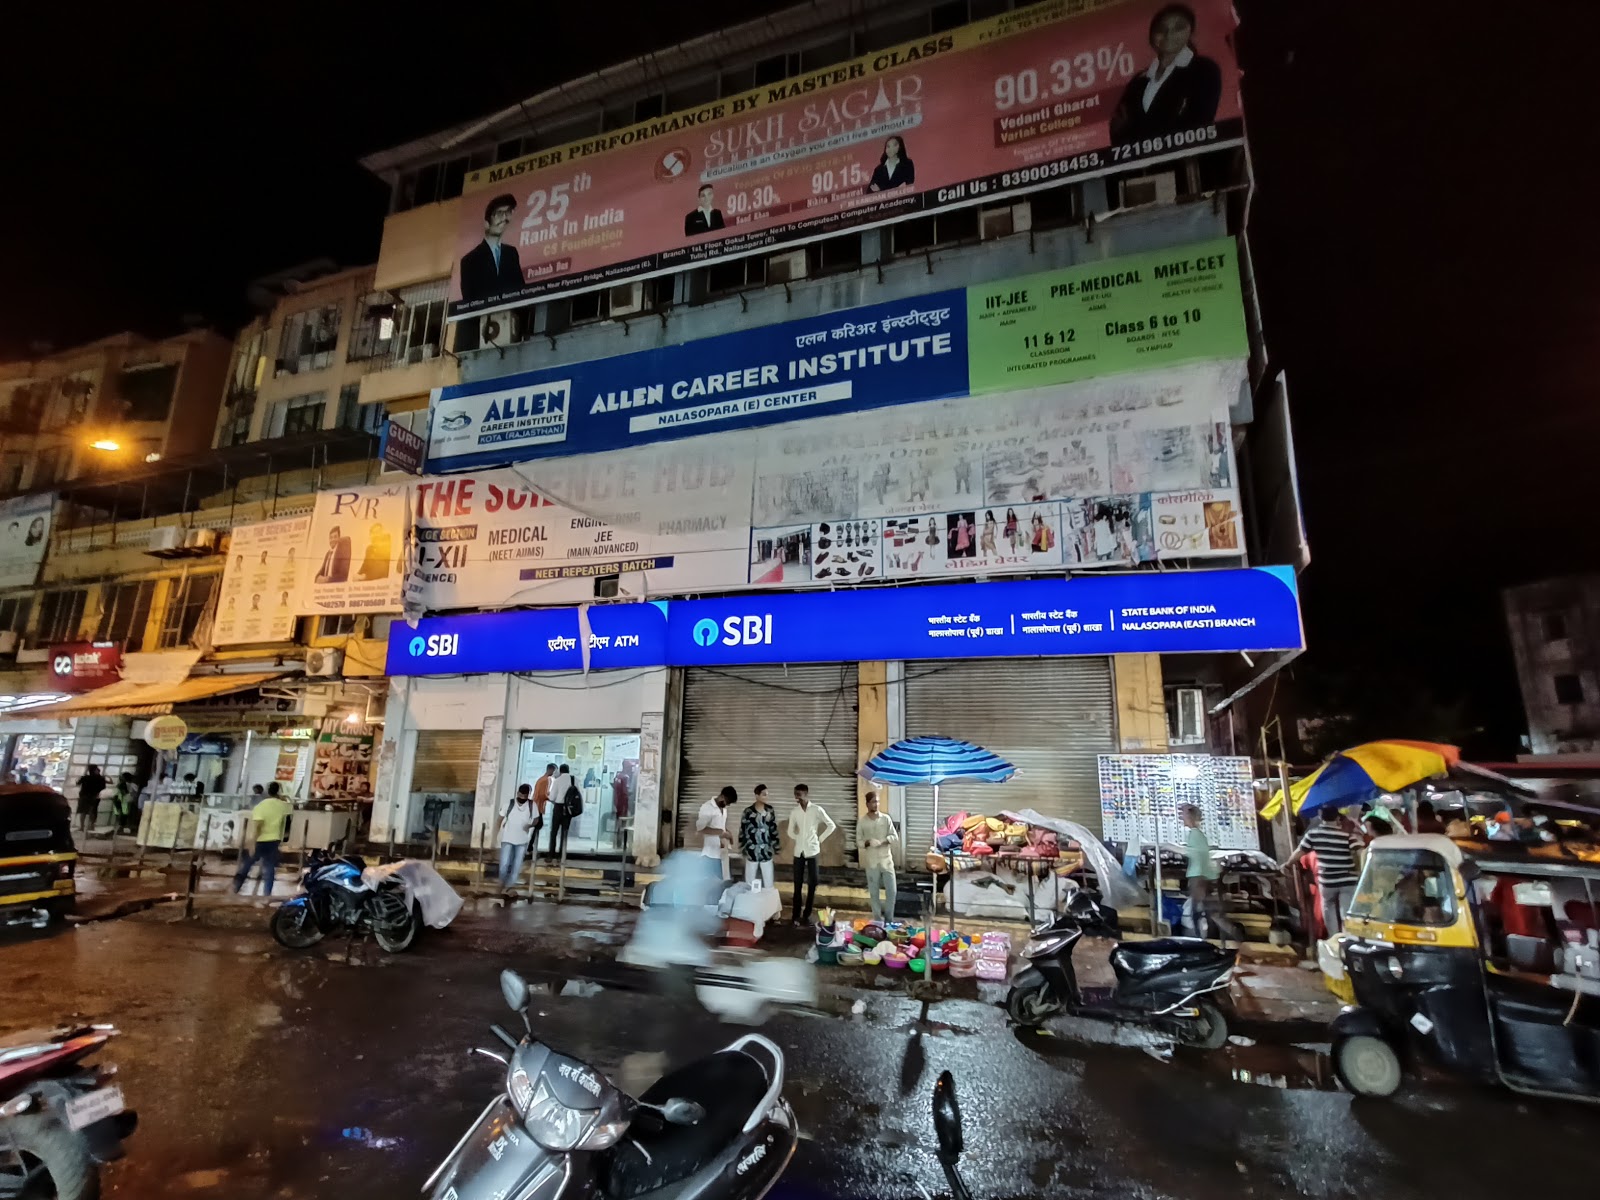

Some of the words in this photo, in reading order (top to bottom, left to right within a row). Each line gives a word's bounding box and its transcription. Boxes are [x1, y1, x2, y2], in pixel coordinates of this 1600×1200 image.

[994, 42, 1135, 111] 90.33%
[488, 151, 563, 184] MASTER
[567, 104, 725, 162] PERFORMANCE
[732, 92, 762, 114] BY
[767, 63, 866, 104] MASTER
[872, 36, 954, 72] CLASS
[703, 112, 786, 158] SUKH
[798, 73, 926, 133] SAGAR
[1000, 106, 1050, 131] Vedanti
[937, 184, 967, 203] Call
[969, 181, 988, 197] Us
[840, 204, 878, 219] Computer
[519, 225, 559, 248] Rank
[562, 219, 579, 237] In
[583, 207, 625, 231] India
[561, 228, 624, 252] Foundation
[985, 290, 1028, 309] IIT-JEE
[1051, 270, 1142, 298] PRE-MEDICAL
[1154, 254, 1226, 279] MHT-CET
[795, 332, 827, 348] एलन
[831, 322, 877, 341] करिअर
[1024, 335, 1038, 349] 11
[1044, 333, 1055, 346] &
[1059, 328, 1076, 343] 12
[1105, 321, 1145, 336] Class
[1149, 316, 1158, 330] 6
[1163, 316, 1178, 327] to
[1183, 308, 1202, 323] 10
[588, 383, 665, 416] ALLEN
[671, 364, 780, 401] CAREER
[788, 332, 952, 381] INSTITUTE
[1006, 361, 1048, 373] INTEGRATED
[483, 389, 566, 423] ALLEN
[657, 402, 740, 425] NALASOPARA
[743, 398, 760, 412] (E)
[763, 390, 817, 408] CENTER
[480, 420, 515, 433] CAREER
[516, 414, 564, 428] INSTITUTE
[480, 433, 504, 443] KOTA
[505, 425, 564, 440] (RAJASTHAN)
[385, 445, 418, 466] ACADEMY
[416, 479, 476, 518] THE
[488, 526, 548, 546] MEDICAL
[593, 531, 613, 543] JEE
[566, 541, 639, 559] (MAIN/ADVANCED)
[535, 568, 559, 579] NEET
[562, 563, 619, 577] REPEATERS
[622, 559, 655, 571] BATCH
[1121, 608, 1147, 617] STATE
[1149, 607, 1173, 616] BANK
[1175, 606, 1188, 615] OF
[1190, 605, 1216, 614] INDIA
[722, 614, 773, 646] SBI
[1121, 622, 1182, 631] NALASOPARA
[1183, 619, 1214, 630] (EAST)
[1215, 618, 1256, 627] BRANCH
[427, 634, 459, 657] SBI
[548, 636, 576, 651] एटीएम
[614, 635, 639, 647] ATM
[322, 718, 339, 734] MY
